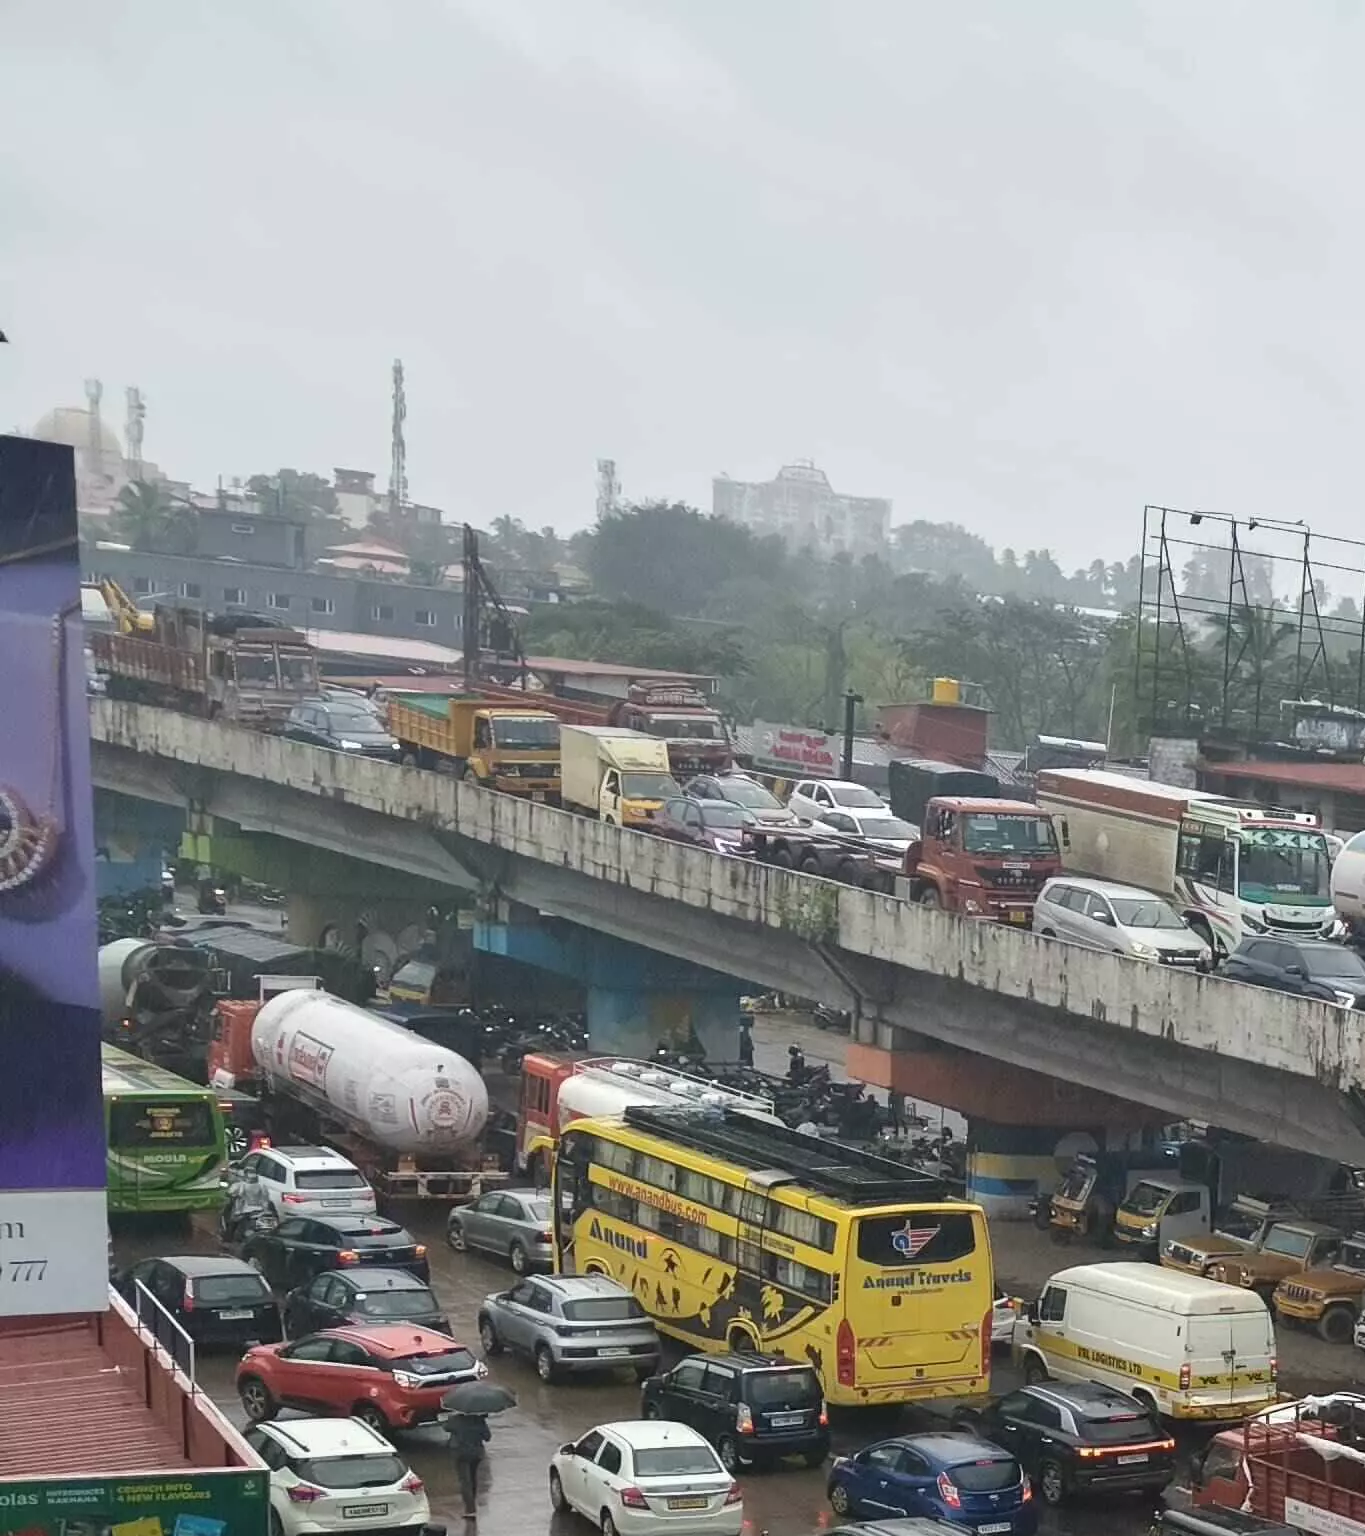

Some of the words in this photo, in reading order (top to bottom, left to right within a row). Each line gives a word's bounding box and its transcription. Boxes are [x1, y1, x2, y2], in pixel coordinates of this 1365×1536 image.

[608, 1175, 709, 1225] www.anandbus.com
[589, 1217, 649, 1260] Anand
[863, 1271, 915, 1289] Anand
[917, 1268, 972, 1285] Travels
[1091, 1349, 1127, 1371] LOGISTICS
[1128, 1360, 1142, 1375] LTD
